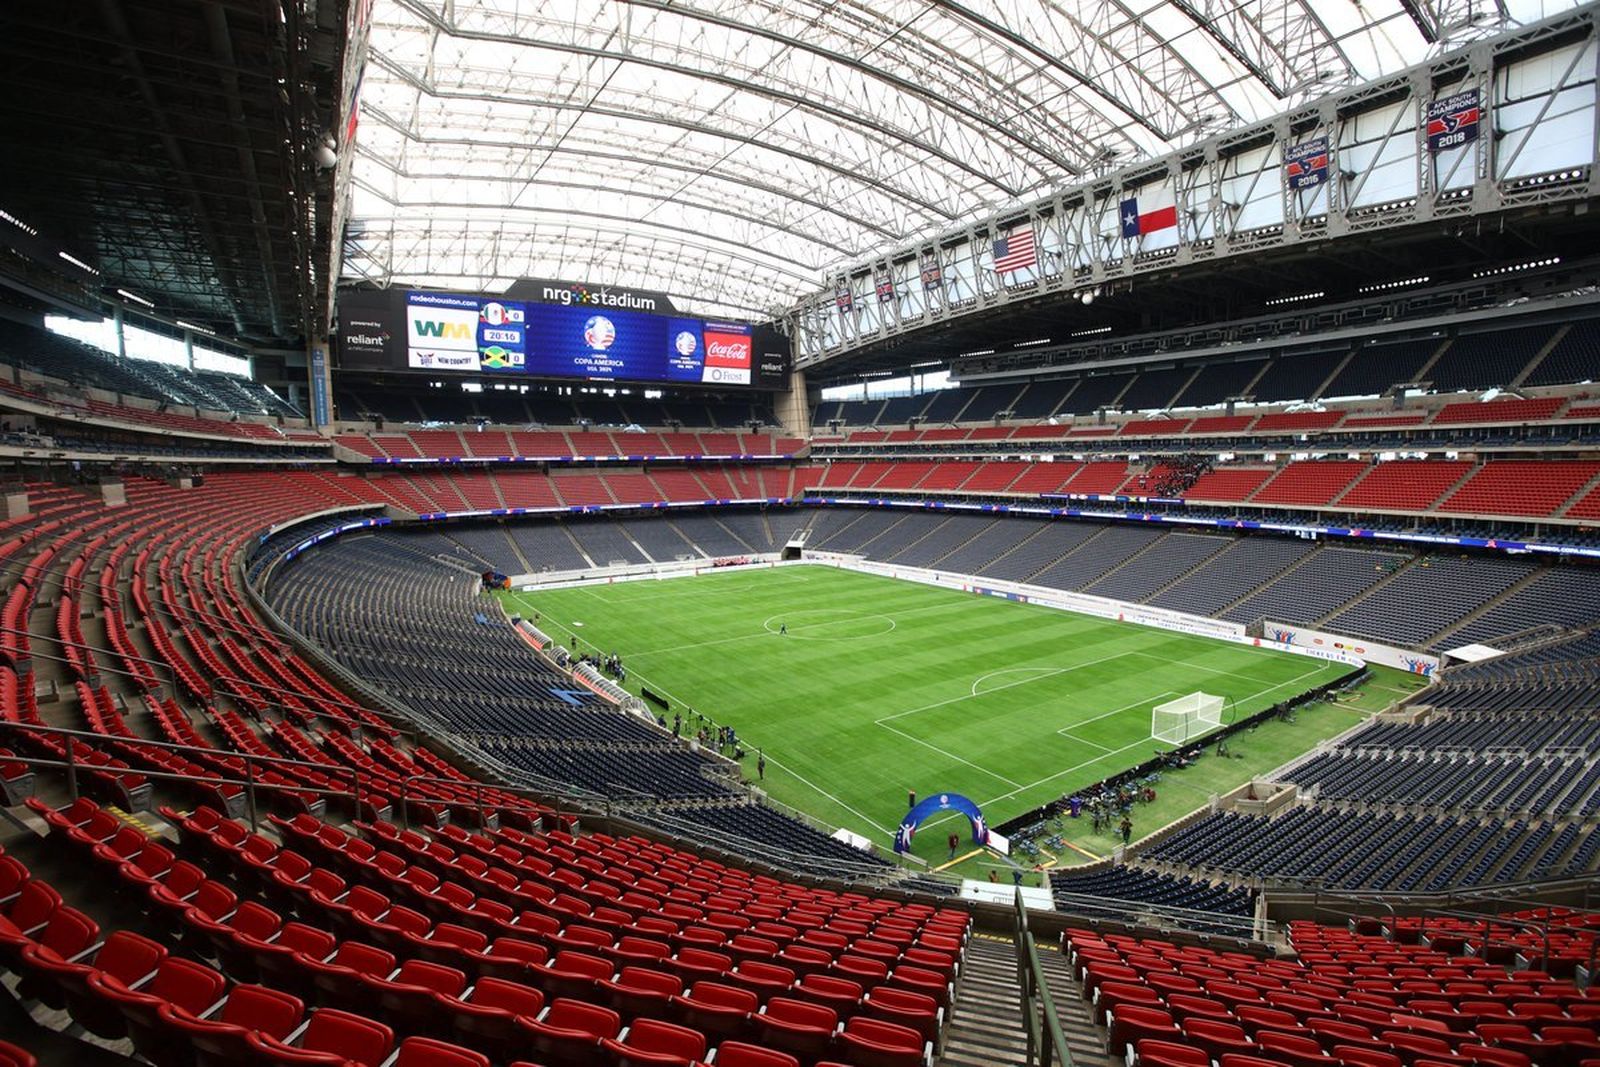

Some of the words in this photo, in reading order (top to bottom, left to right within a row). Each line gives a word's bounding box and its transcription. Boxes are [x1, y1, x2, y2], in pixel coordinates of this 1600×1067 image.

[1428, 97, 1477, 117] CHAMPIONS
[1434, 101, 1446, 109] AFC
[1448, 93, 1472, 104] SOUTH
[1438, 132, 1466, 148] 2018
[1285, 144, 1327, 160] CHAMPIONS
[1297, 174, 1319, 187] 2016
[410, 295, 478, 307] rodeohouston.com
[543, 287, 572, 306] nrg
[591, 292, 656, 310] stadium
[513, 312, 520, 320] 0
[414, 320, 472, 340] WM
[347, 334, 384, 346] reliant
[707, 341, 748, 360] Coca-Cola
[514, 355, 520, 363] 0
[574, 357, 593, 365] COPA
[594, 358, 625, 367] AMERICA
[723, 371, 743, 381] Frost
